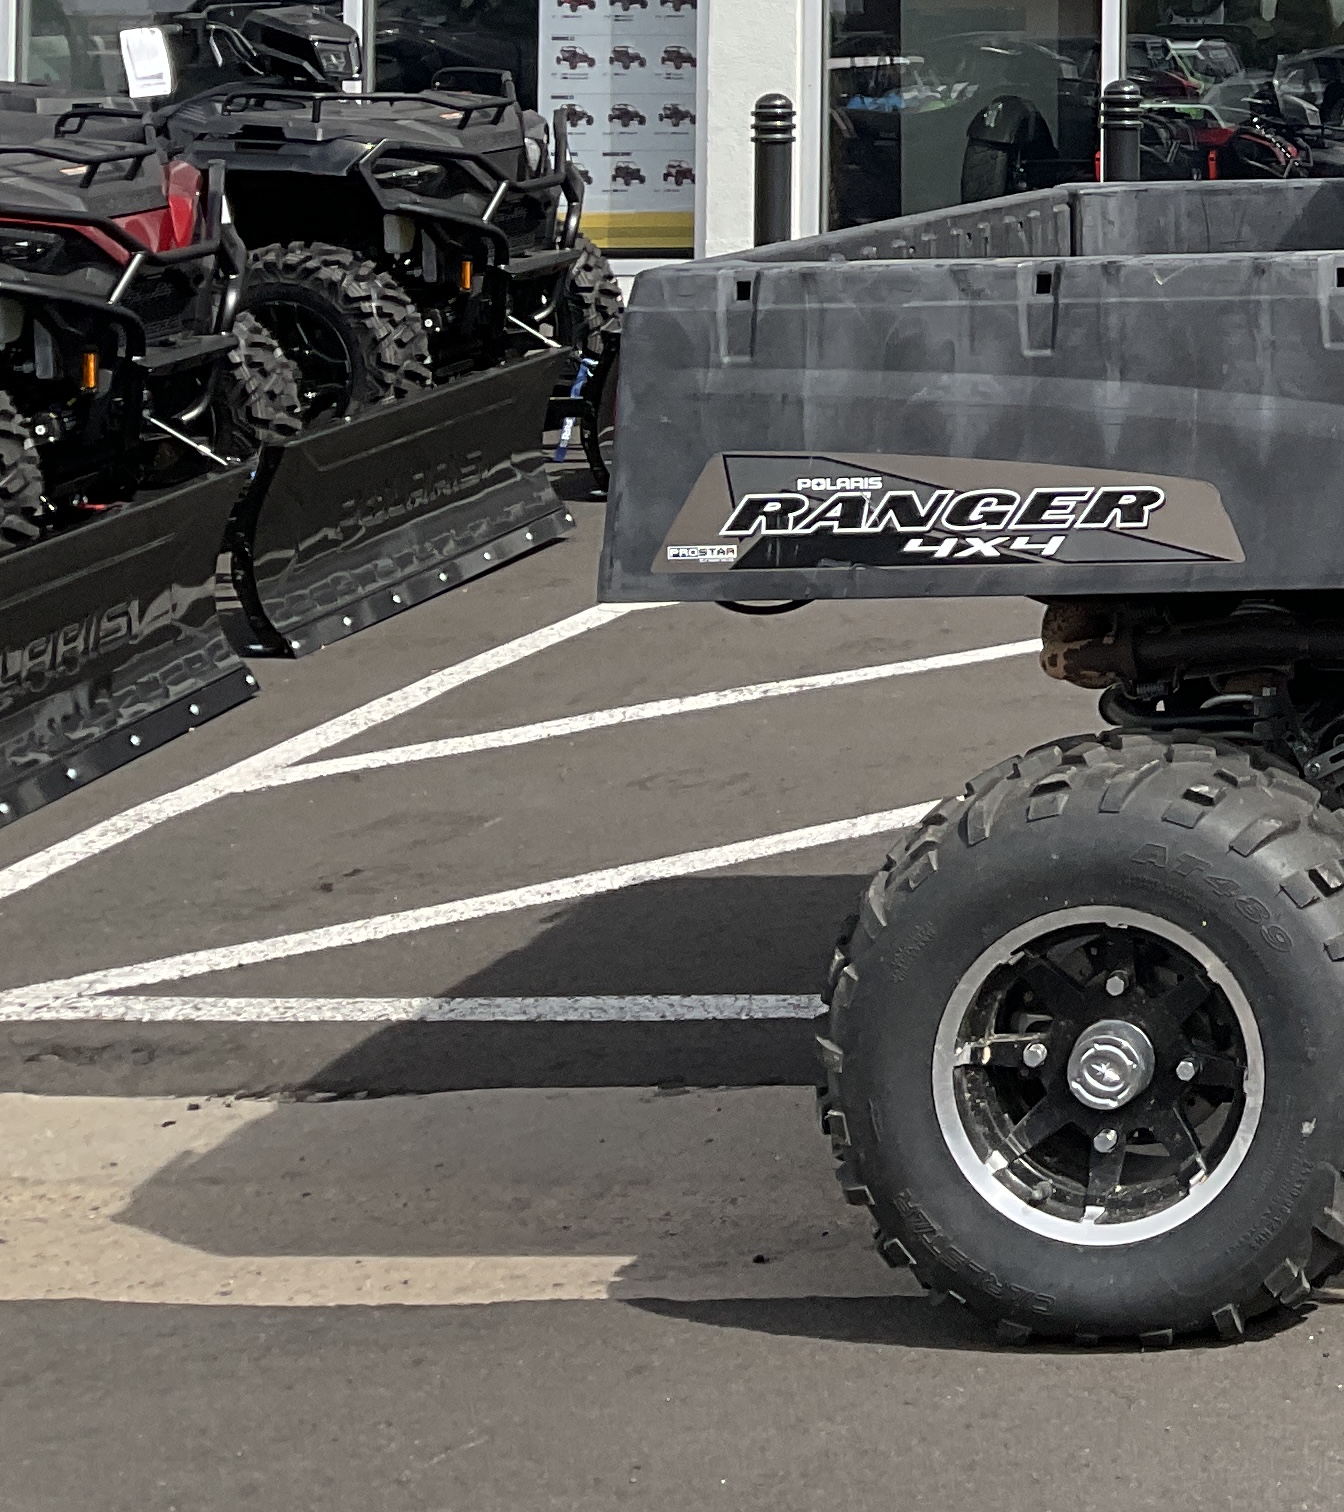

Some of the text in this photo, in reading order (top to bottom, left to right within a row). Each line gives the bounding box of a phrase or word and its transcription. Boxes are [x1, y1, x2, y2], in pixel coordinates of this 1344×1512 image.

[797, 477, 882, 491] POLARIS
[718, 485, 1168, 536] RANGER
[668, 547, 736, 558] PROSTAR
